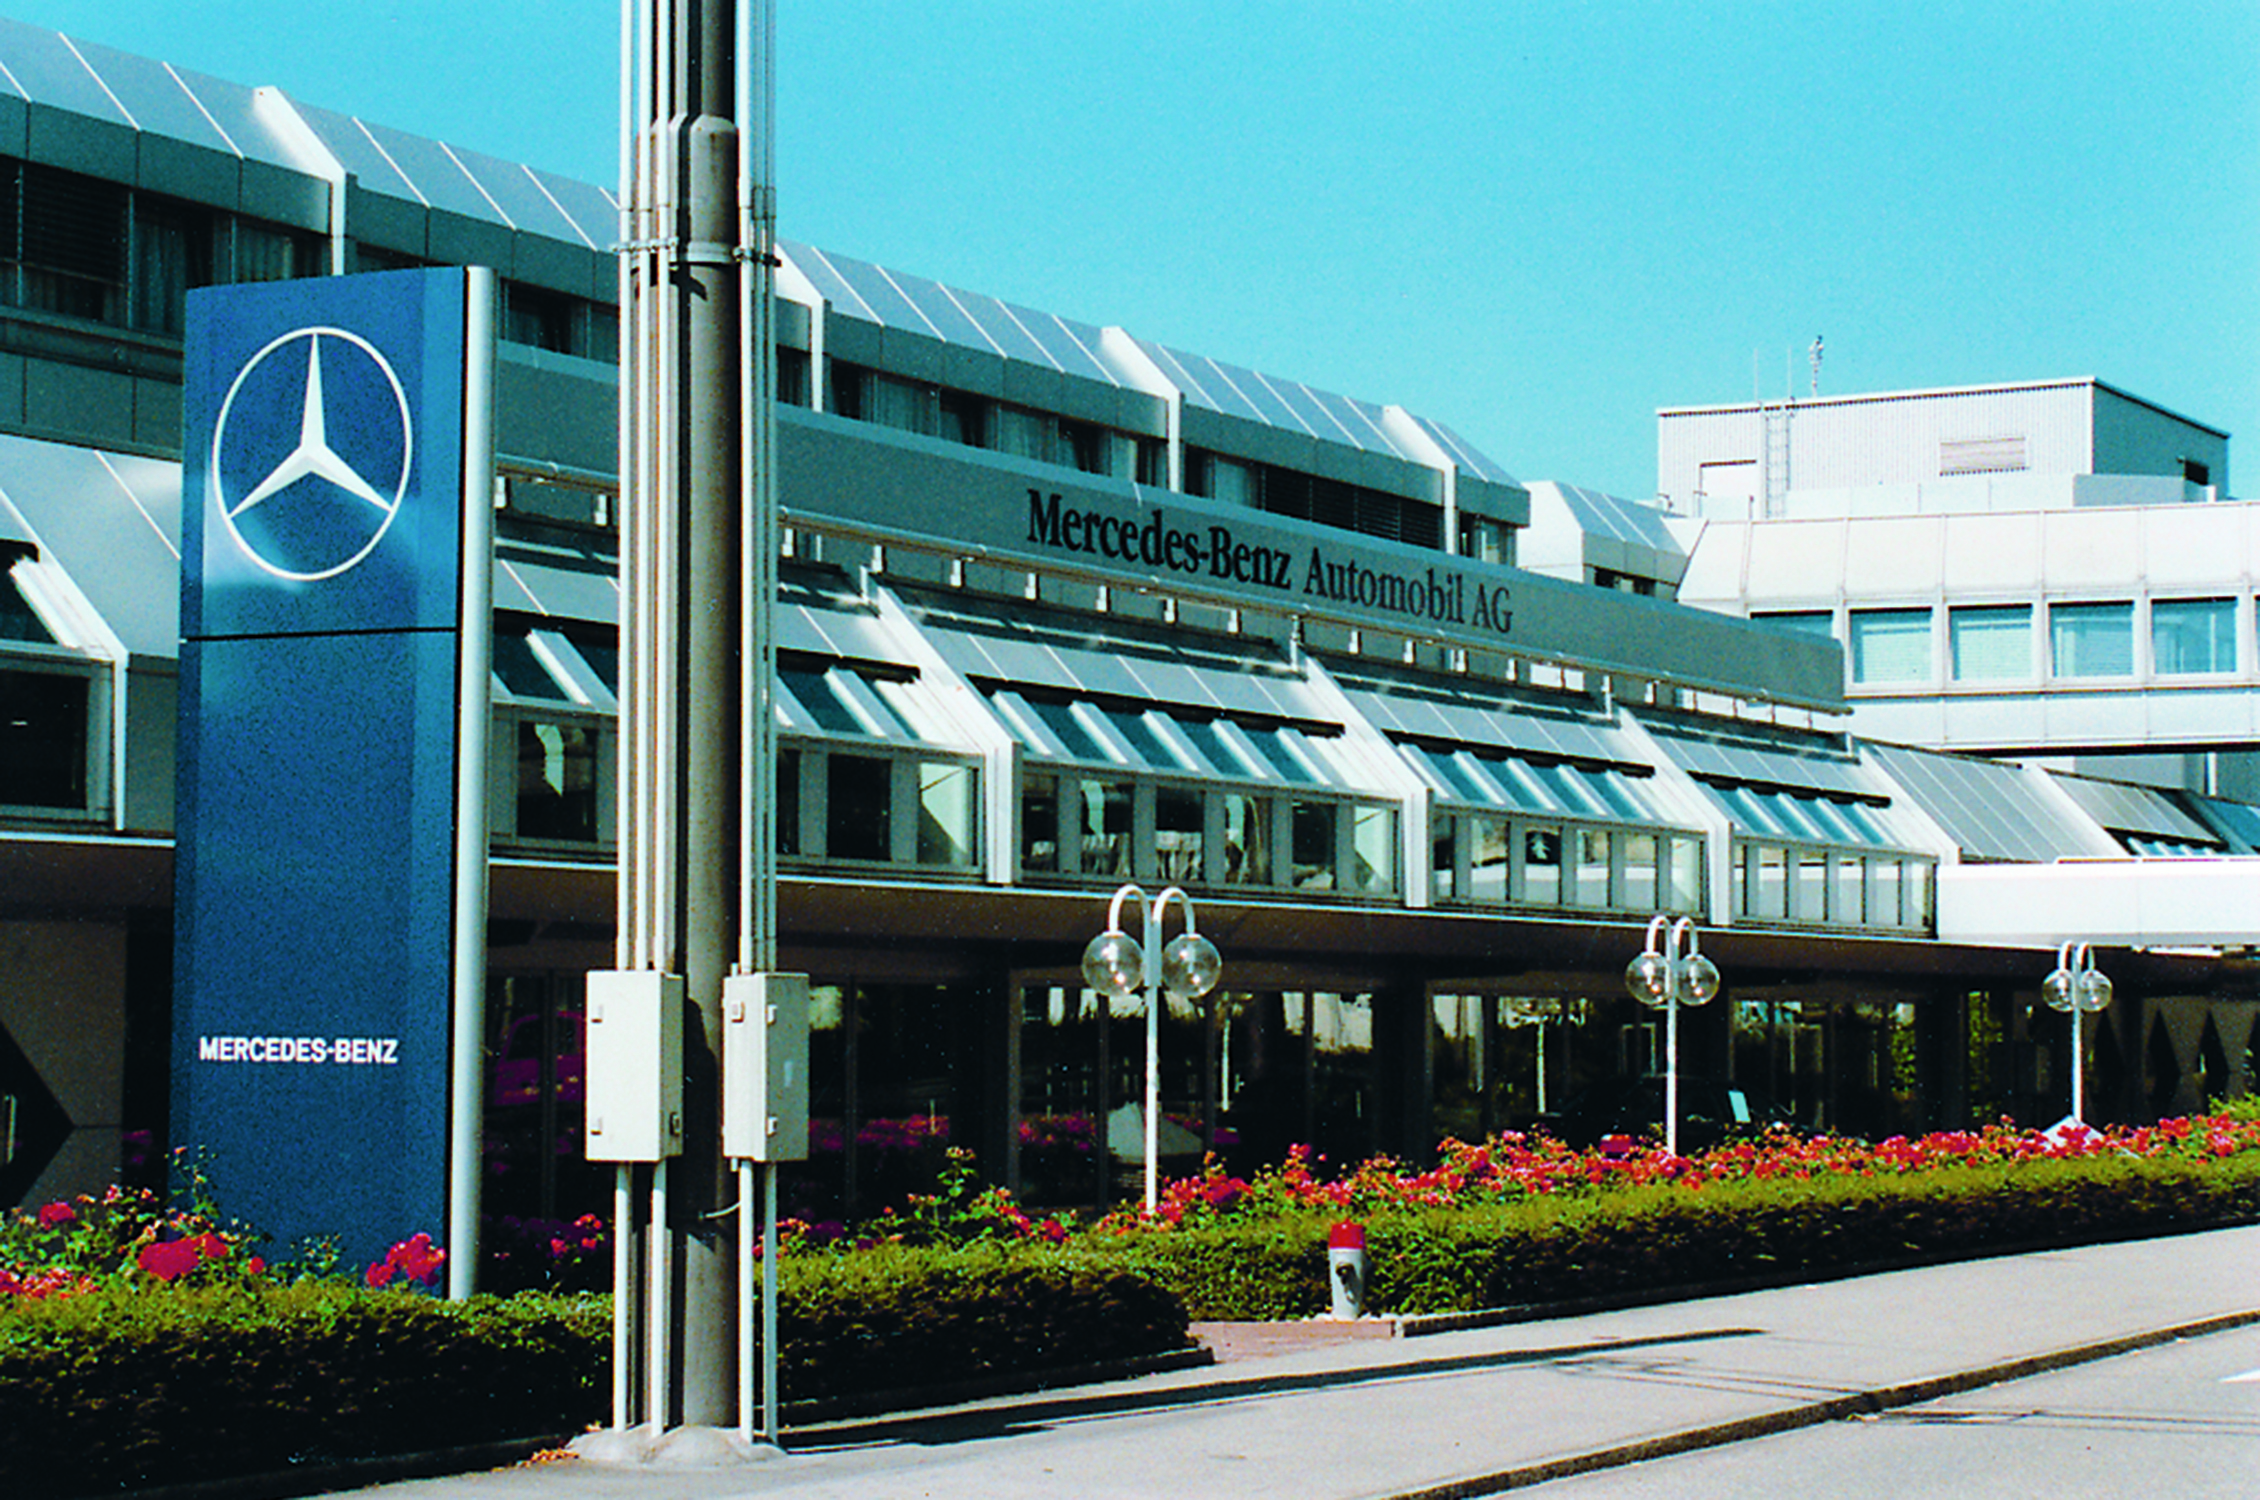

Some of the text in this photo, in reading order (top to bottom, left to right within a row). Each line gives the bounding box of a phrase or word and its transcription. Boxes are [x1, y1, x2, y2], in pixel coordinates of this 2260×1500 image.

[1027, 488, 1513, 633] Mercedes-Benz Automobil AG
[200, 1036, 398, 1064] MERCEDES-BENZ
